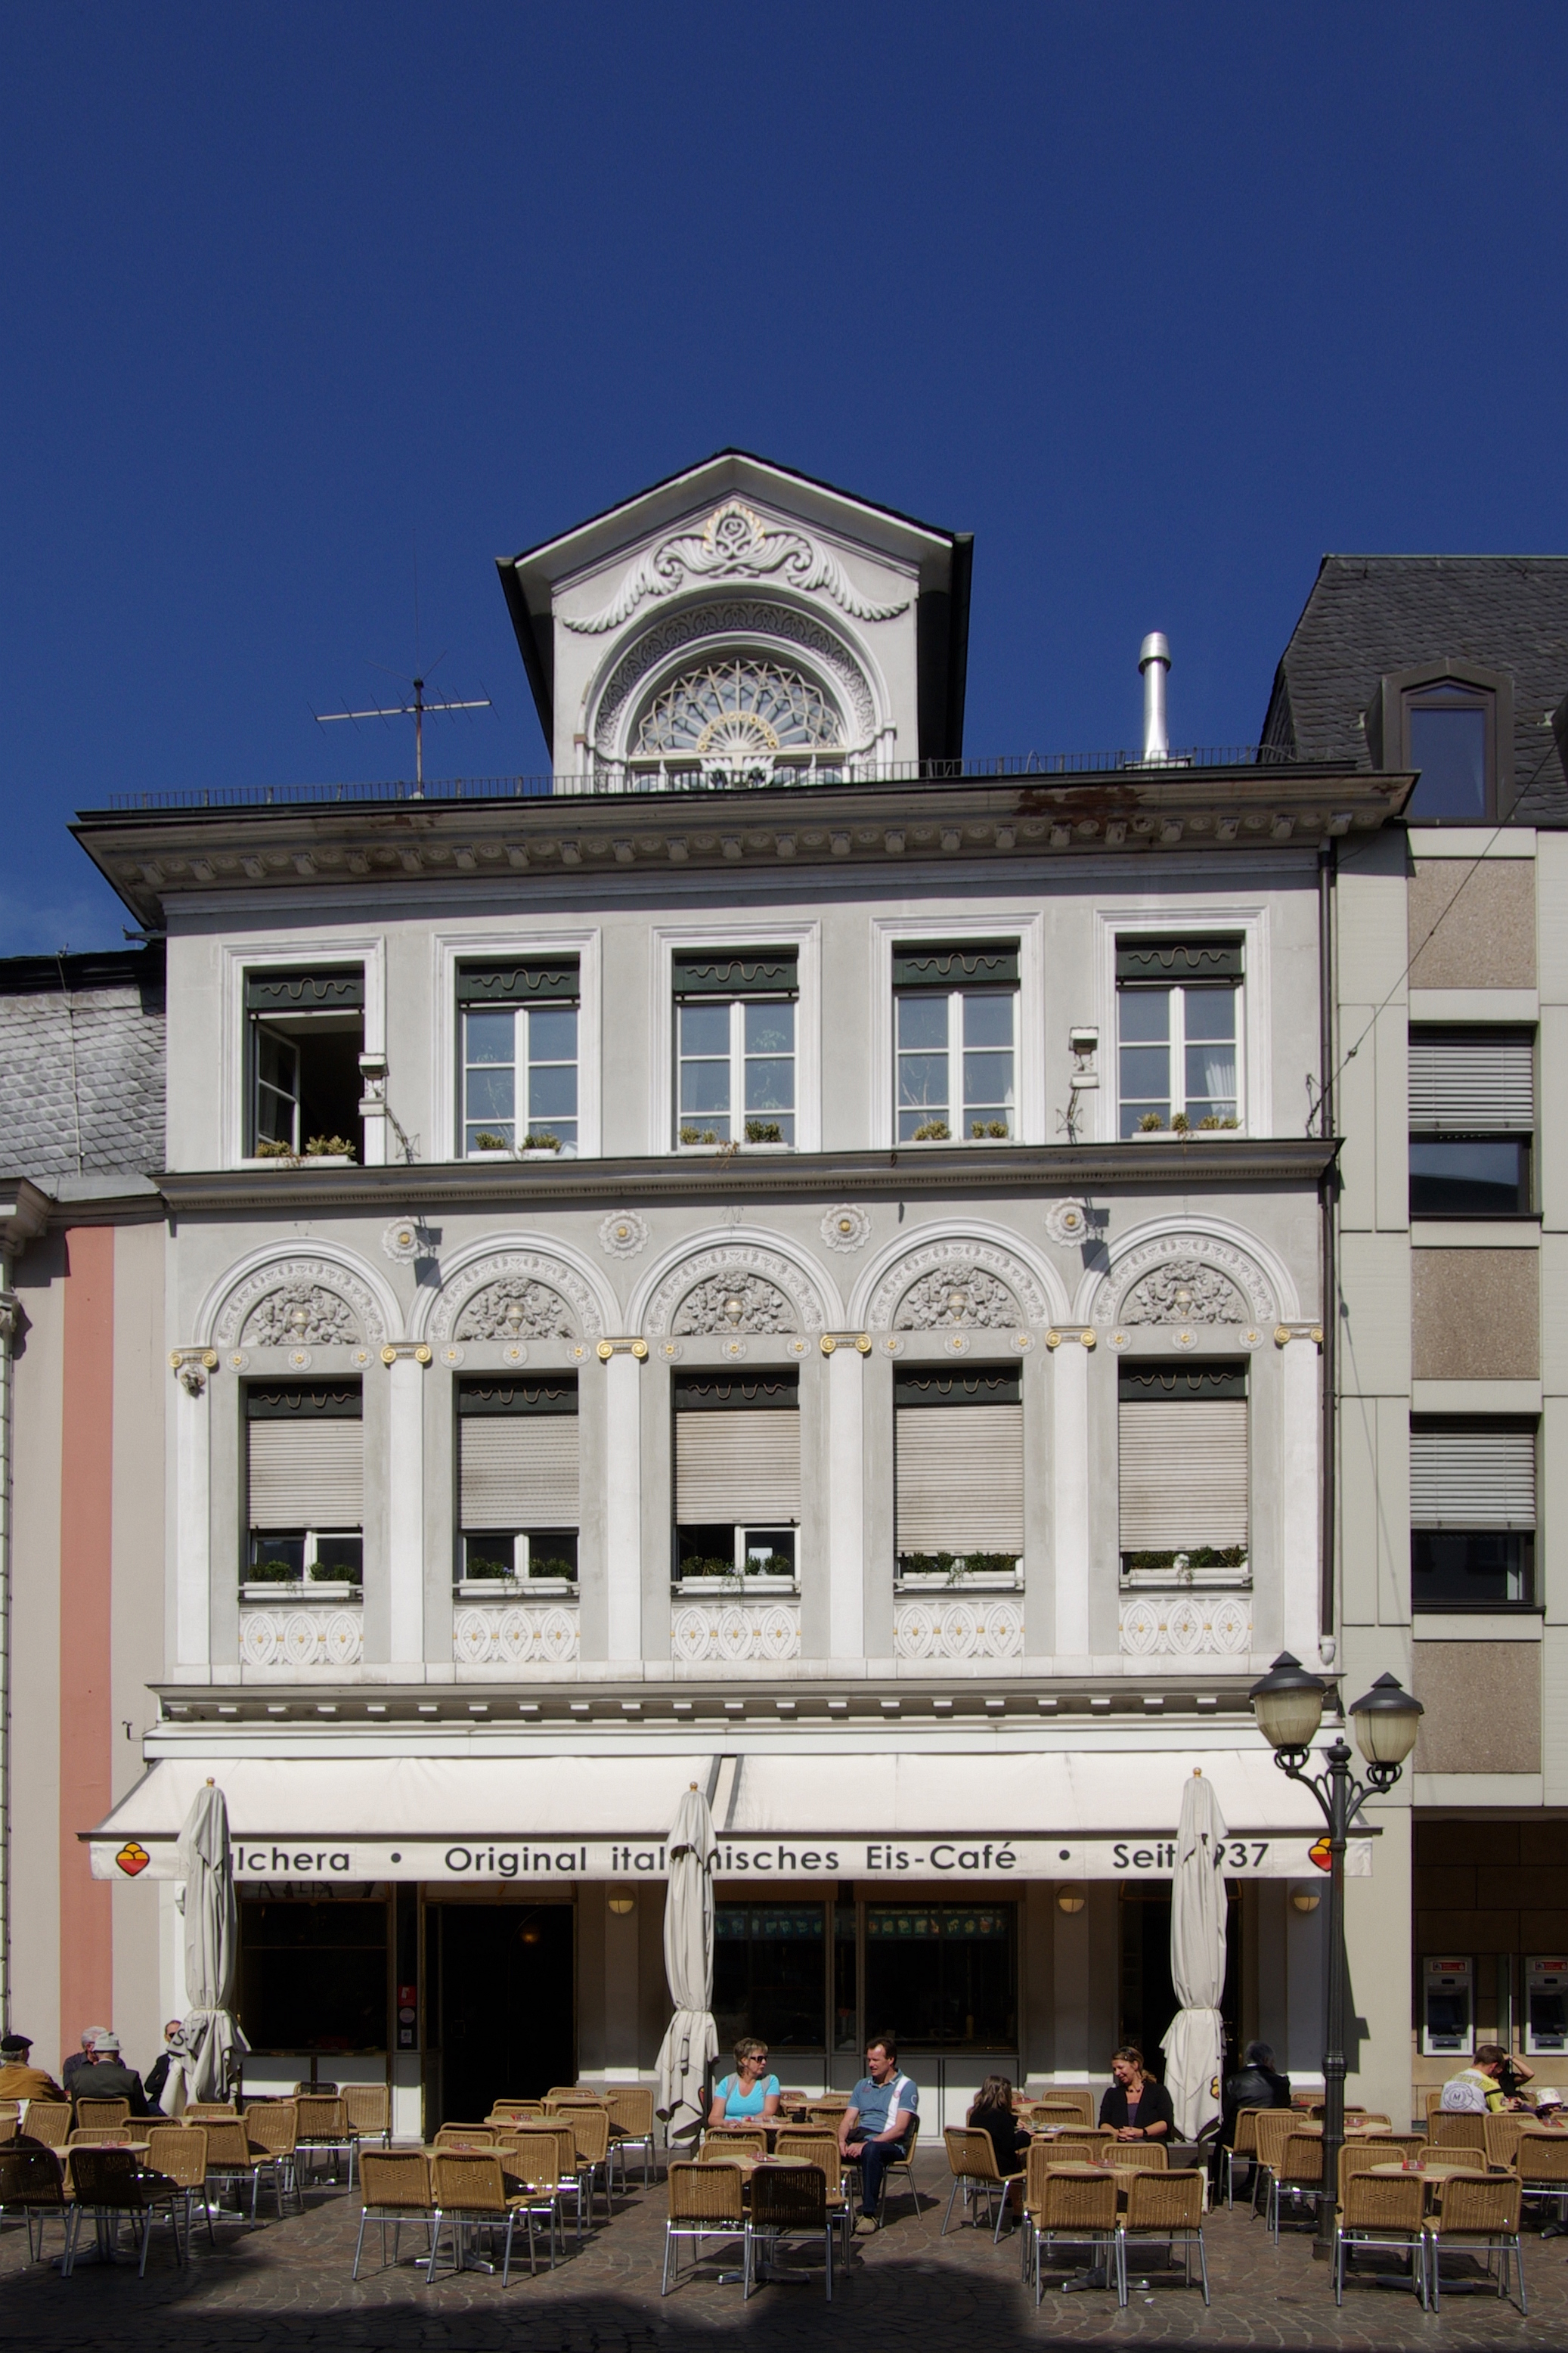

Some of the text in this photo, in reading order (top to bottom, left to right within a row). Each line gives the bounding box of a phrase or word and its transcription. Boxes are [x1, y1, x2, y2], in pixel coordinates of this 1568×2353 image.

[231, 1846, 350, 1872] lchera
[445, 1846, 587, 1878] Original
[612, 1846, 840, 1872] italisches
[866, 1841, 1017, 1871] Eis-Café
[1113, 1843, 1176, 1869] Seit
